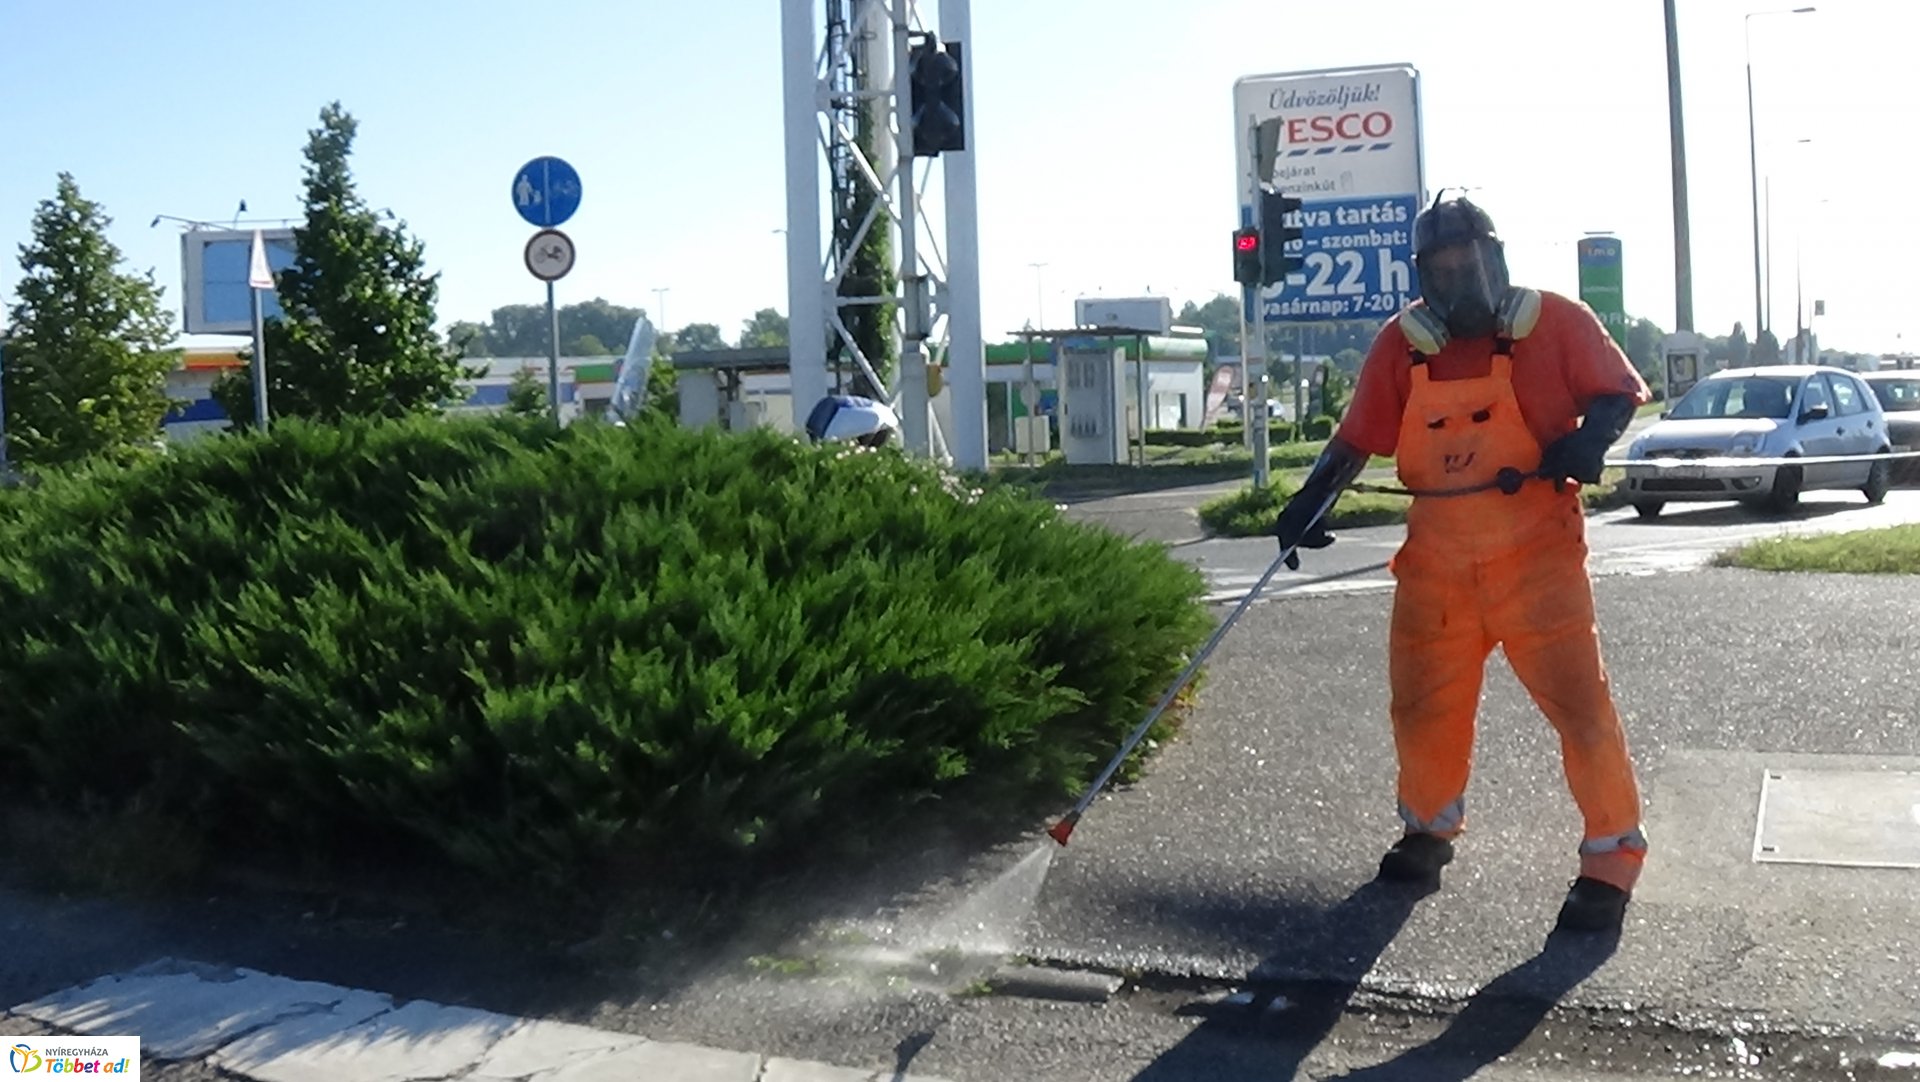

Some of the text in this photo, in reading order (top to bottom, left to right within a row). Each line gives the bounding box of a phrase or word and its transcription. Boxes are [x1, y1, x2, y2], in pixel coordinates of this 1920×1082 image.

[1269, 84, 1381, 110] Üdvözöljük!
[1285, 111, 1393, 144] ESCO
[1335, 201, 1408, 225] tartás
[1321, 228, 1408, 249] szombat:
[1378, 248, 1411, 293] h
[1353, 293, 1395, 313] 7-20
